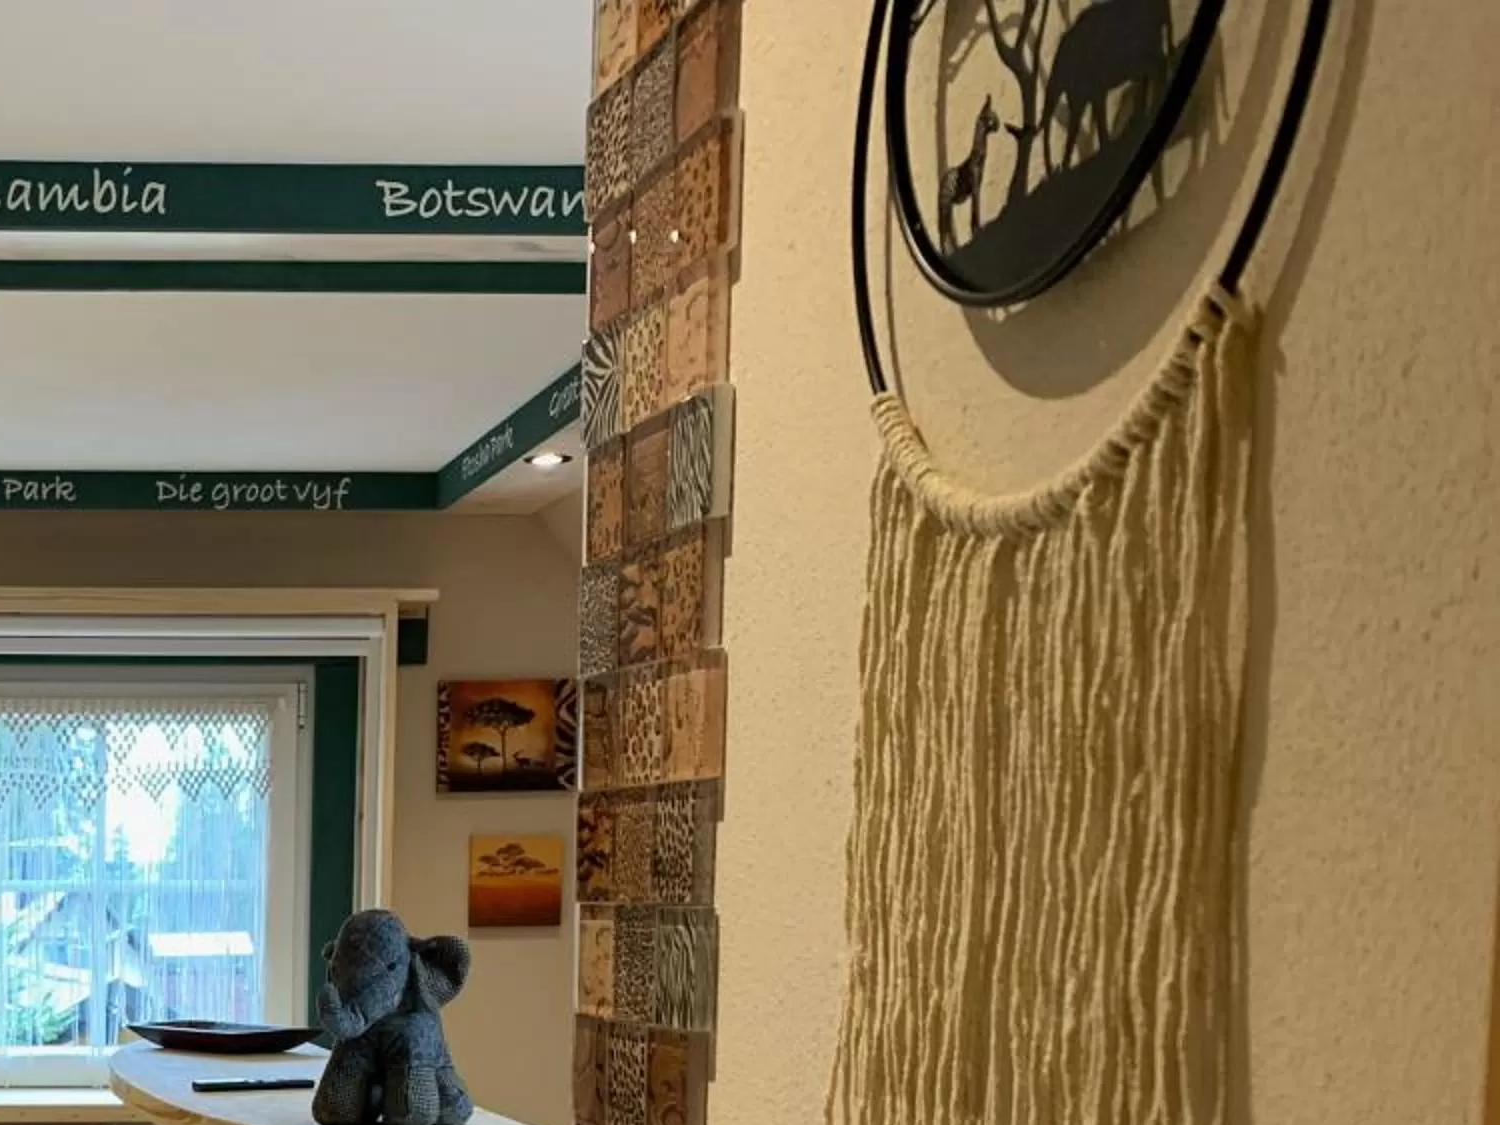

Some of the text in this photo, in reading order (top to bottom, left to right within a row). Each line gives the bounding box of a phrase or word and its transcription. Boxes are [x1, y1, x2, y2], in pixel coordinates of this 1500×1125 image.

[375, 178, 586, 219] Botswan
[3, 475, 77, 501] Park
[155, 474, 351, 509] Die groot vyf
